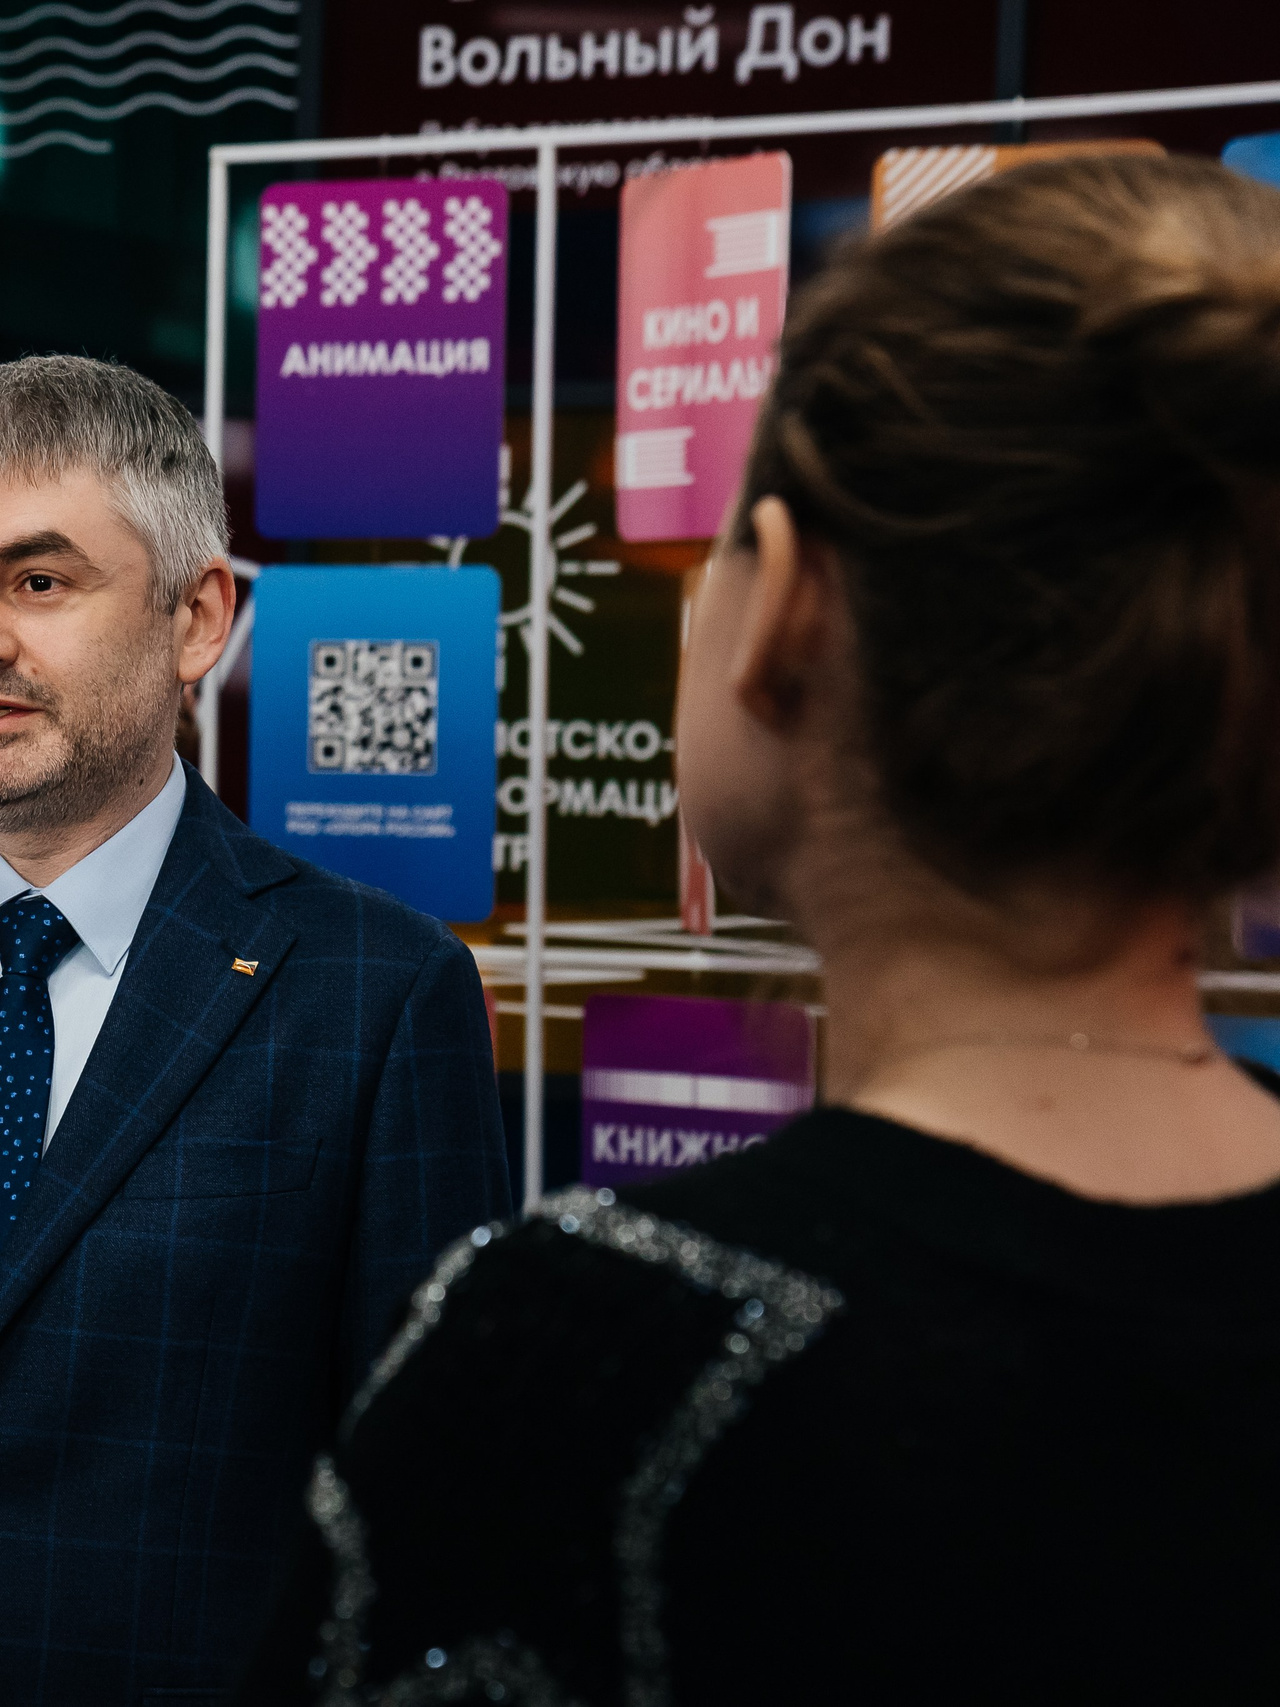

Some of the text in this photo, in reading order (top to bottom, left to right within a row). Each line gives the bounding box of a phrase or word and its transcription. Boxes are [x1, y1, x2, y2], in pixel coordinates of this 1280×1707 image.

[420, 4, 891, 88] Вольный Дон
[643, 296, 759, 350] КИНО И
[280, 338, 490, 378] АНИМАЦИЯ
[592, 1123, 767, 1167] КНИЖН
